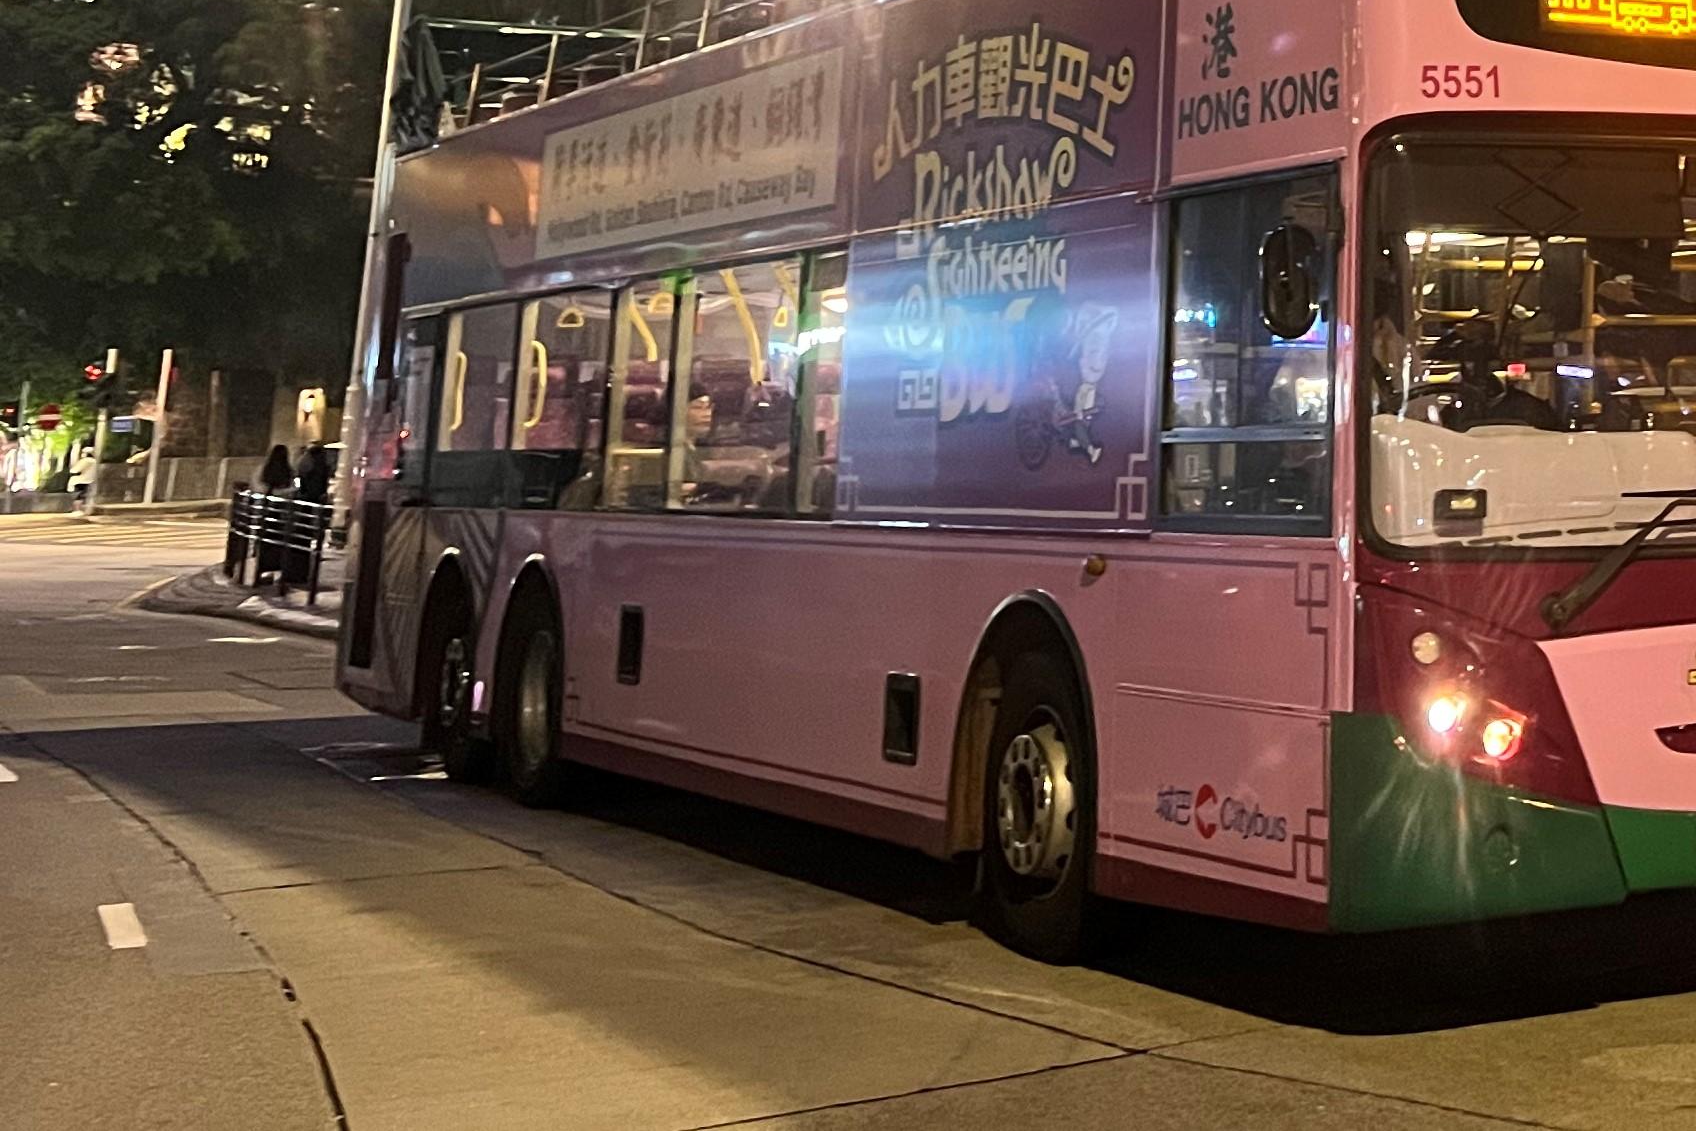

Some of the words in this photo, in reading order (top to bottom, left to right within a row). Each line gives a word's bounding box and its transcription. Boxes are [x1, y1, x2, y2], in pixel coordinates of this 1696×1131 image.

[873, 22, 1135, 181] 人力車觀光巴士
[1177, 86, 1250, 140] HONG
[1259, 68, 1340, 123] KONG
[1421, 64, 1499, 99] 5551
[896, 137, 1077, 260] Rickshaw
[1220, 796, 1287, 842] Citybus
